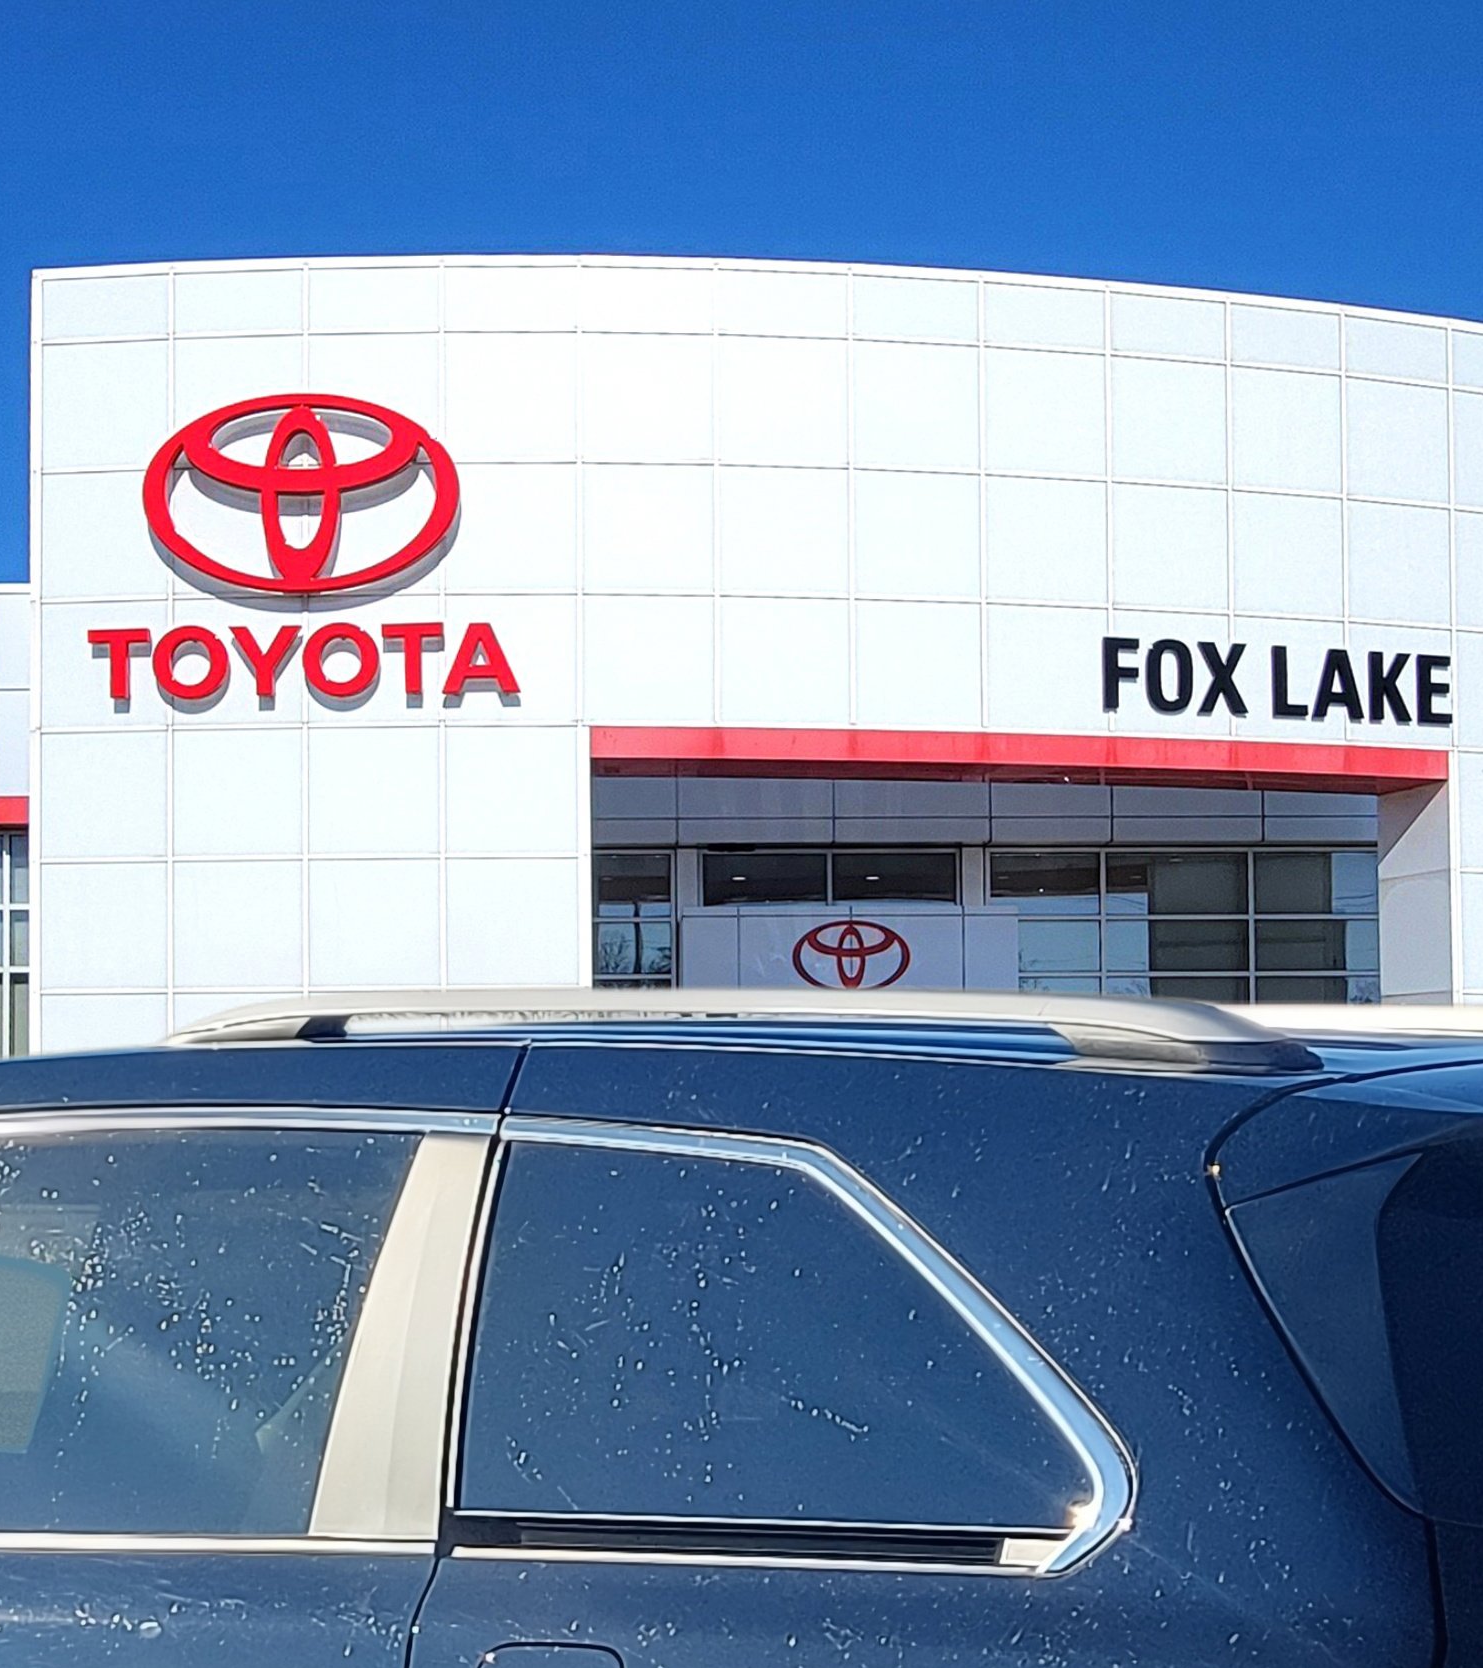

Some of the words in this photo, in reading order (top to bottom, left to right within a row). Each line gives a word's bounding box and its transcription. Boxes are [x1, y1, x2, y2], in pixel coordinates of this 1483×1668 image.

[87, 622, 521, 704] TOYOTA
[1102, 636, 1249, 716] FOX
[1271, 645, 1453, 725] LAKE
